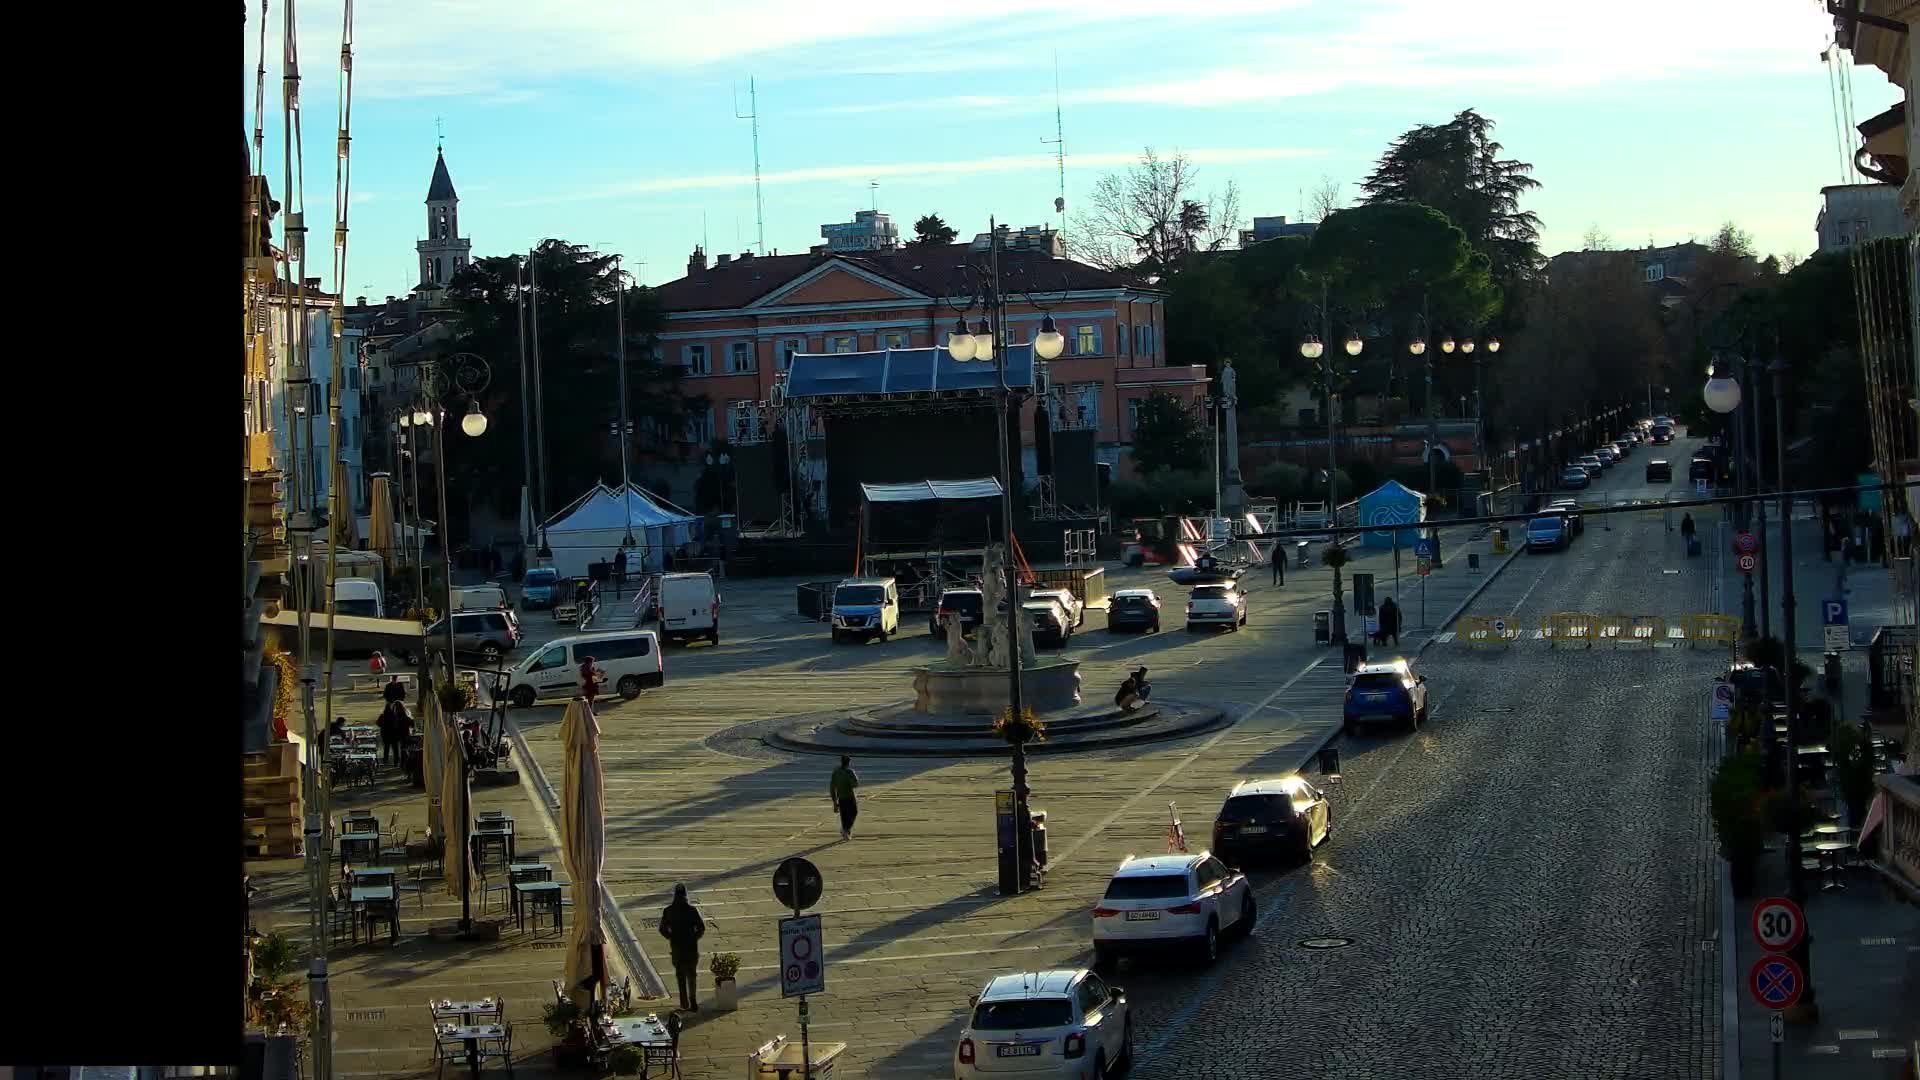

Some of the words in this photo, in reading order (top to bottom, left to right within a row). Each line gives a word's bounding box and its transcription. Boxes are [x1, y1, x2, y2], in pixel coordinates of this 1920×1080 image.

[1743, 558, 1752, 567] 20
[1826, 602, 1842, 622] P
[1763, 912, 1791, 938] 30
